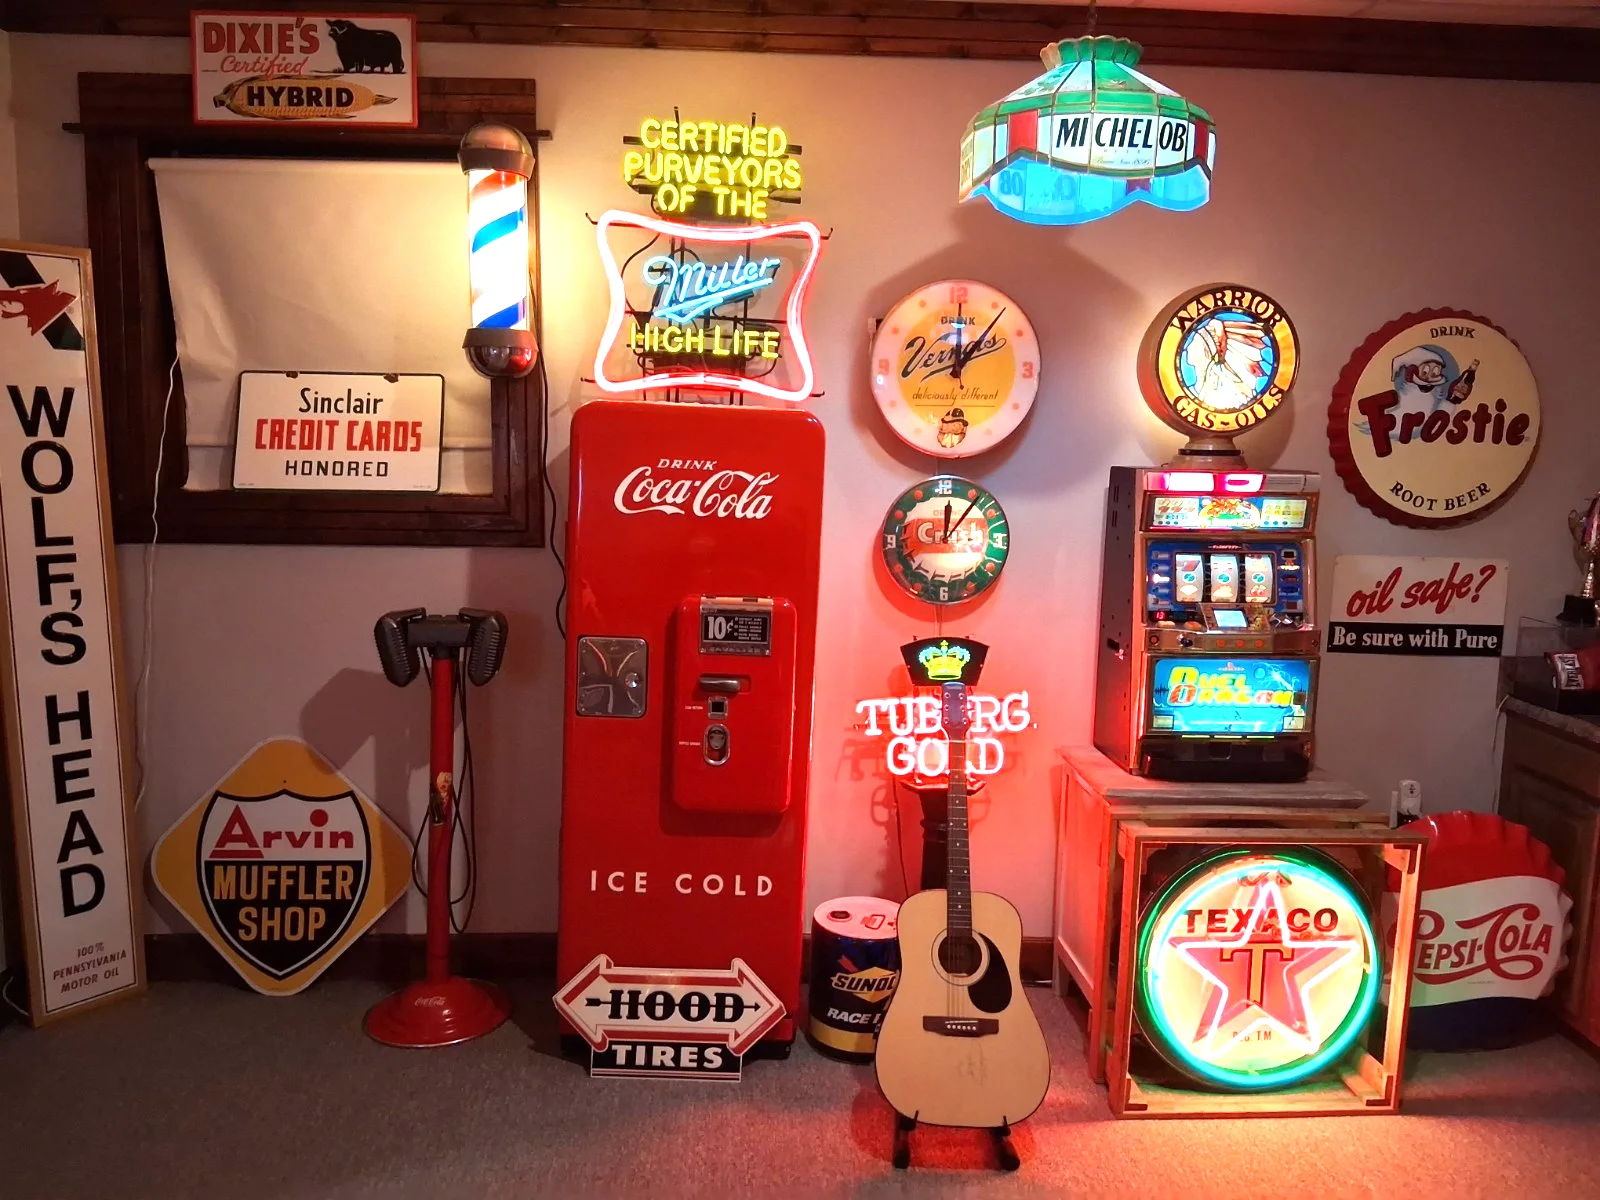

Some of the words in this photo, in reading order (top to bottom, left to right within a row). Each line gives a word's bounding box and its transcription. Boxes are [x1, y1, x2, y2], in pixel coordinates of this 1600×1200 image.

[203, 18, 321, 54] DIXIE'S
[220, 55, 309, 81] Certified
[247, 86, 354, 108] HYBRID
[640, 119, 788, 158] CERTIFIED
[623, 151, 802, 189] PURVEYORS
[657, 184, 696, 212] OF
[713, 187, 768, 219] THE
[642, 256, 780, 307] Miller
[950, 287, 968, 304] 12
[1170, 290, 1283, 333] WARRIOR
[630, 323, 704, 353] HIGH
[713, 325, 780, 359] LIFE
[1430, 326, 1476, 339] DRINK
[1022, 361, 1033, 378] 3
[299, 387, 383, 414] Sinclair
[912, 388, 957, 405] deliciously
[961, 387, 998, 400] different
[255, 418, 339, 450] CREDIT
[346, 421, 422, 452] CARDS
[1358, 389, 1530, 458] Frostie
[285, 460, 388, 477] HONORED
[657, 458, 717, 471] DRINK
[613, 466, 780, 520] Coca-Cola
[1390, 481, 1437, 511] ROOT
[1444, 482, 1492, 511] BEER
[6, 384, 87, 666] WOLF'S
[917, 521, 985, 546] Crush
[940, 587, 948, 600] 6
[1346, 566, 1402, 617] oil
[1401, 562, 1496, 615] safe?
[707, 616, 734, 640] 10¢
[1333, 626, 1356, 646] Be
[1362, 631, 1403, 647] sure
[1408, 629, 1449, 648] with
[1454, 629, 1497, 649] Pure
[887, 737, 1004, 777] GOD
[45, 690, 105, 918] HEAD
[209, 804, 354, 859] Arvin
[213, 865, 354, 900] MUFFLER
[590, 870, 648, 893] ICE
[675, 873, 773, 897] COLD
[238, 907, 326, 941] SHOP
[1184, 907, 1339, 934] TEXACO
[53, 949, 127, 980] PENNSYLVANIA
[77, 942, 104, 958] 100%
[61, 974, 98, 993] MOTOR
[104, 967, 119, 979] OIL
[608, 990, 744, 1023] HOOD
[827, 1007, 871, 1024] RACE
[612, 1045, 723, 1069] TIRES
